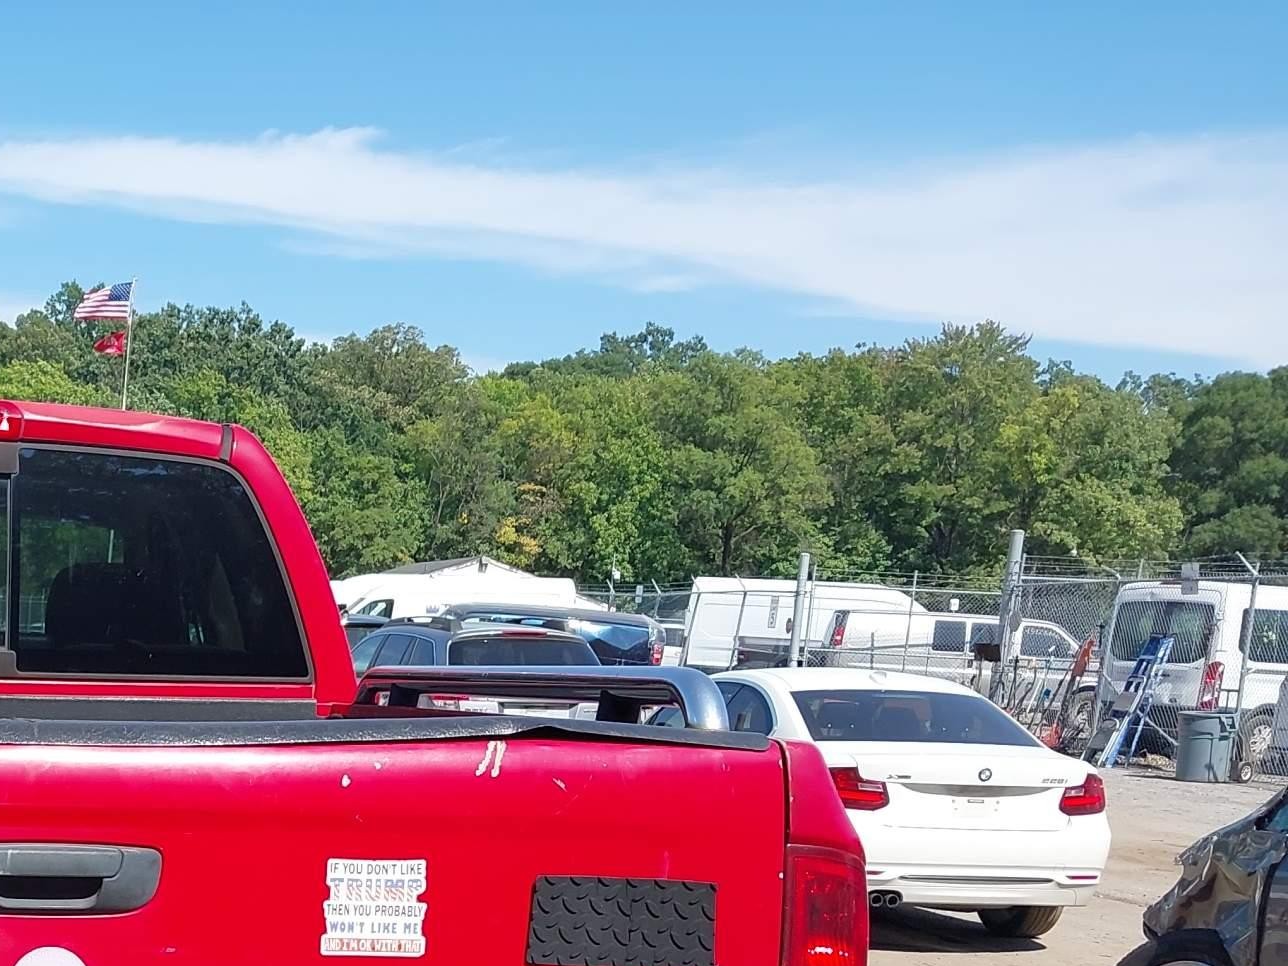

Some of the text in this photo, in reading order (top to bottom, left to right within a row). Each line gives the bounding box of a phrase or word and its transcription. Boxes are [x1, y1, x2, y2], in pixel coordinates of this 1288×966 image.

[330, 862, 423, 875] IF YOU DON'T LIKE
[329, 877, 423, 902] TRUMP
[326, 903, 423, 917] THEN YOU PROBABLY
[329, 921, 419, 934] WON'T LIKE ME
[325, 938, 341, 951] AND
[359, 939, 372, 952] OK
[374, 939, 398, 952] WITH
[398, 939, 422, 953] THAT
